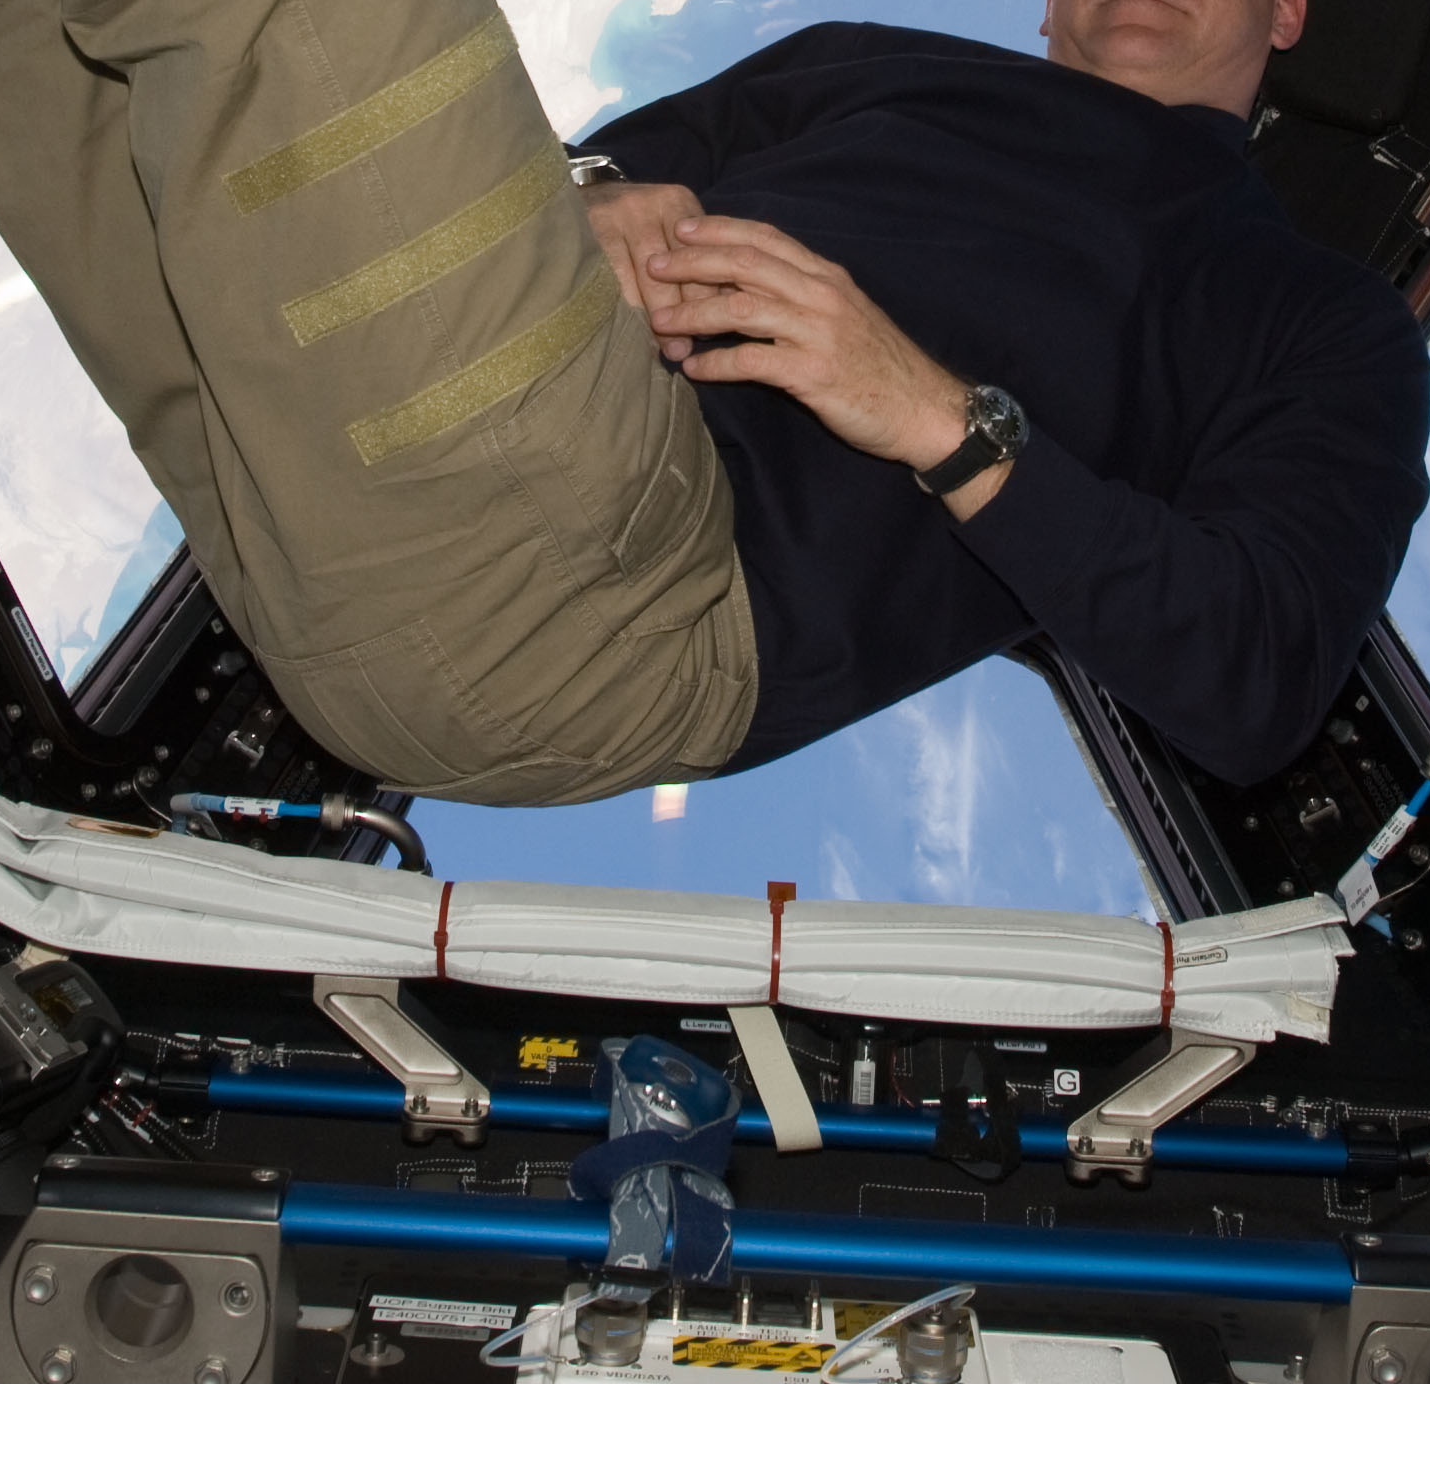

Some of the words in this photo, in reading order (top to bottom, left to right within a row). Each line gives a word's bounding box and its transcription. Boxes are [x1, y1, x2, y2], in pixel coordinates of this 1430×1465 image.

[1175, 955, 1191, 964] Pnl
[1192, 951, 1221, 961] Curtain
[1057, 1072, 1076, 1092] G
[417, 1299, 476, 1312] Support
[481, 1305, 512, 1315] Brkt
